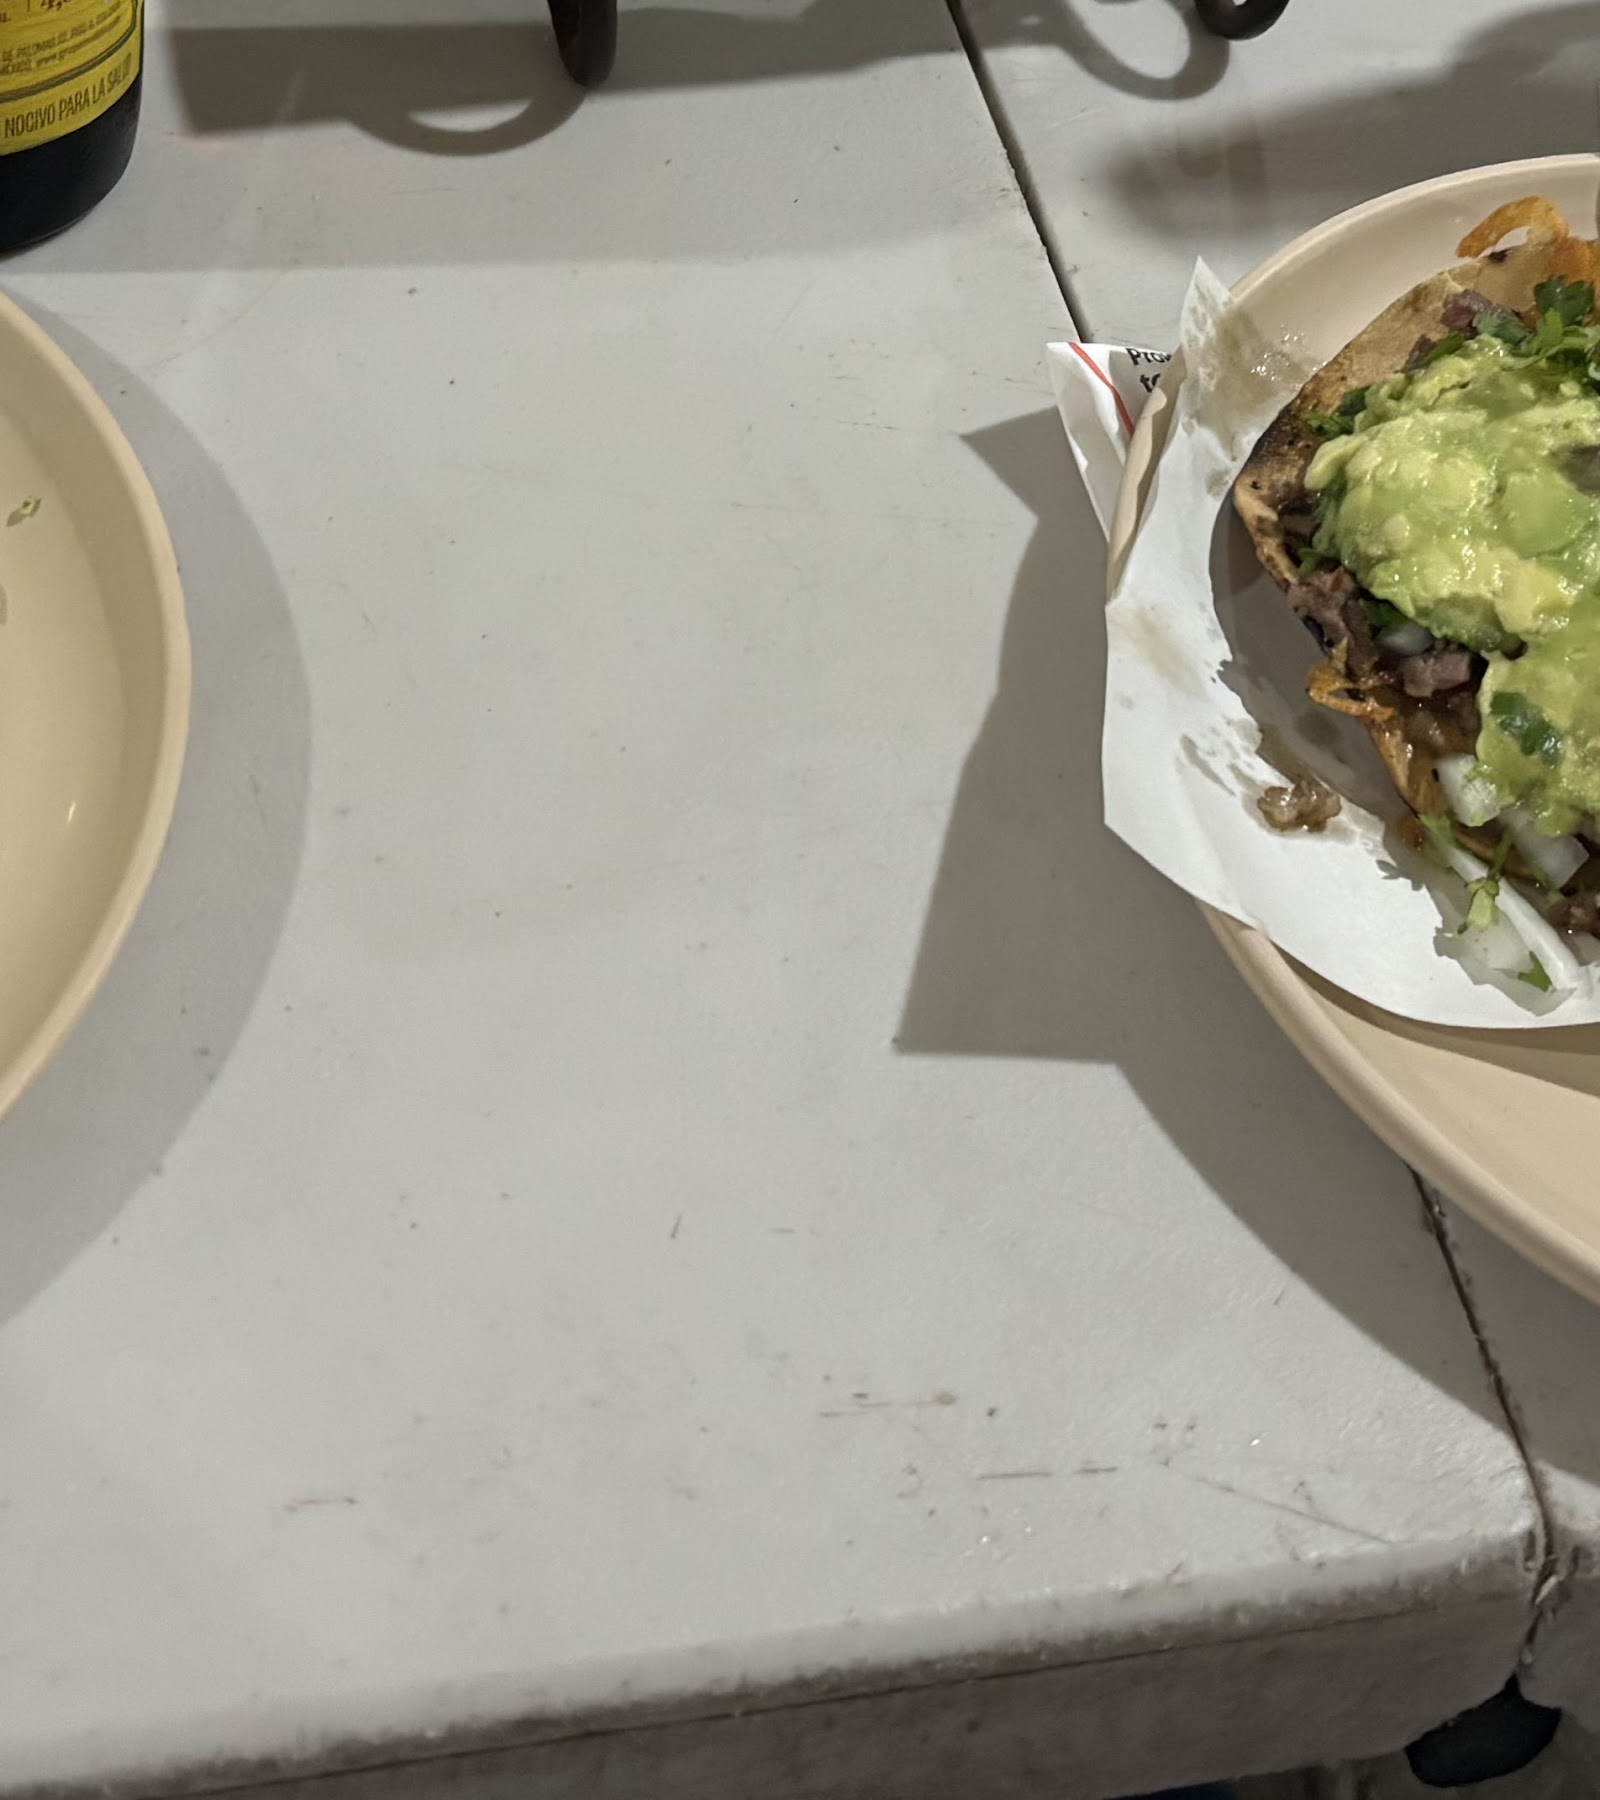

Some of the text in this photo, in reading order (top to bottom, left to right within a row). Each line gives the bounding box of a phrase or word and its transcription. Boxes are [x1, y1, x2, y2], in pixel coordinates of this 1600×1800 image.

[4, 102, 56, 139] NOCIVO
[58, 86, 91, 122] PARA
[92, 76, 106, 105] LA
